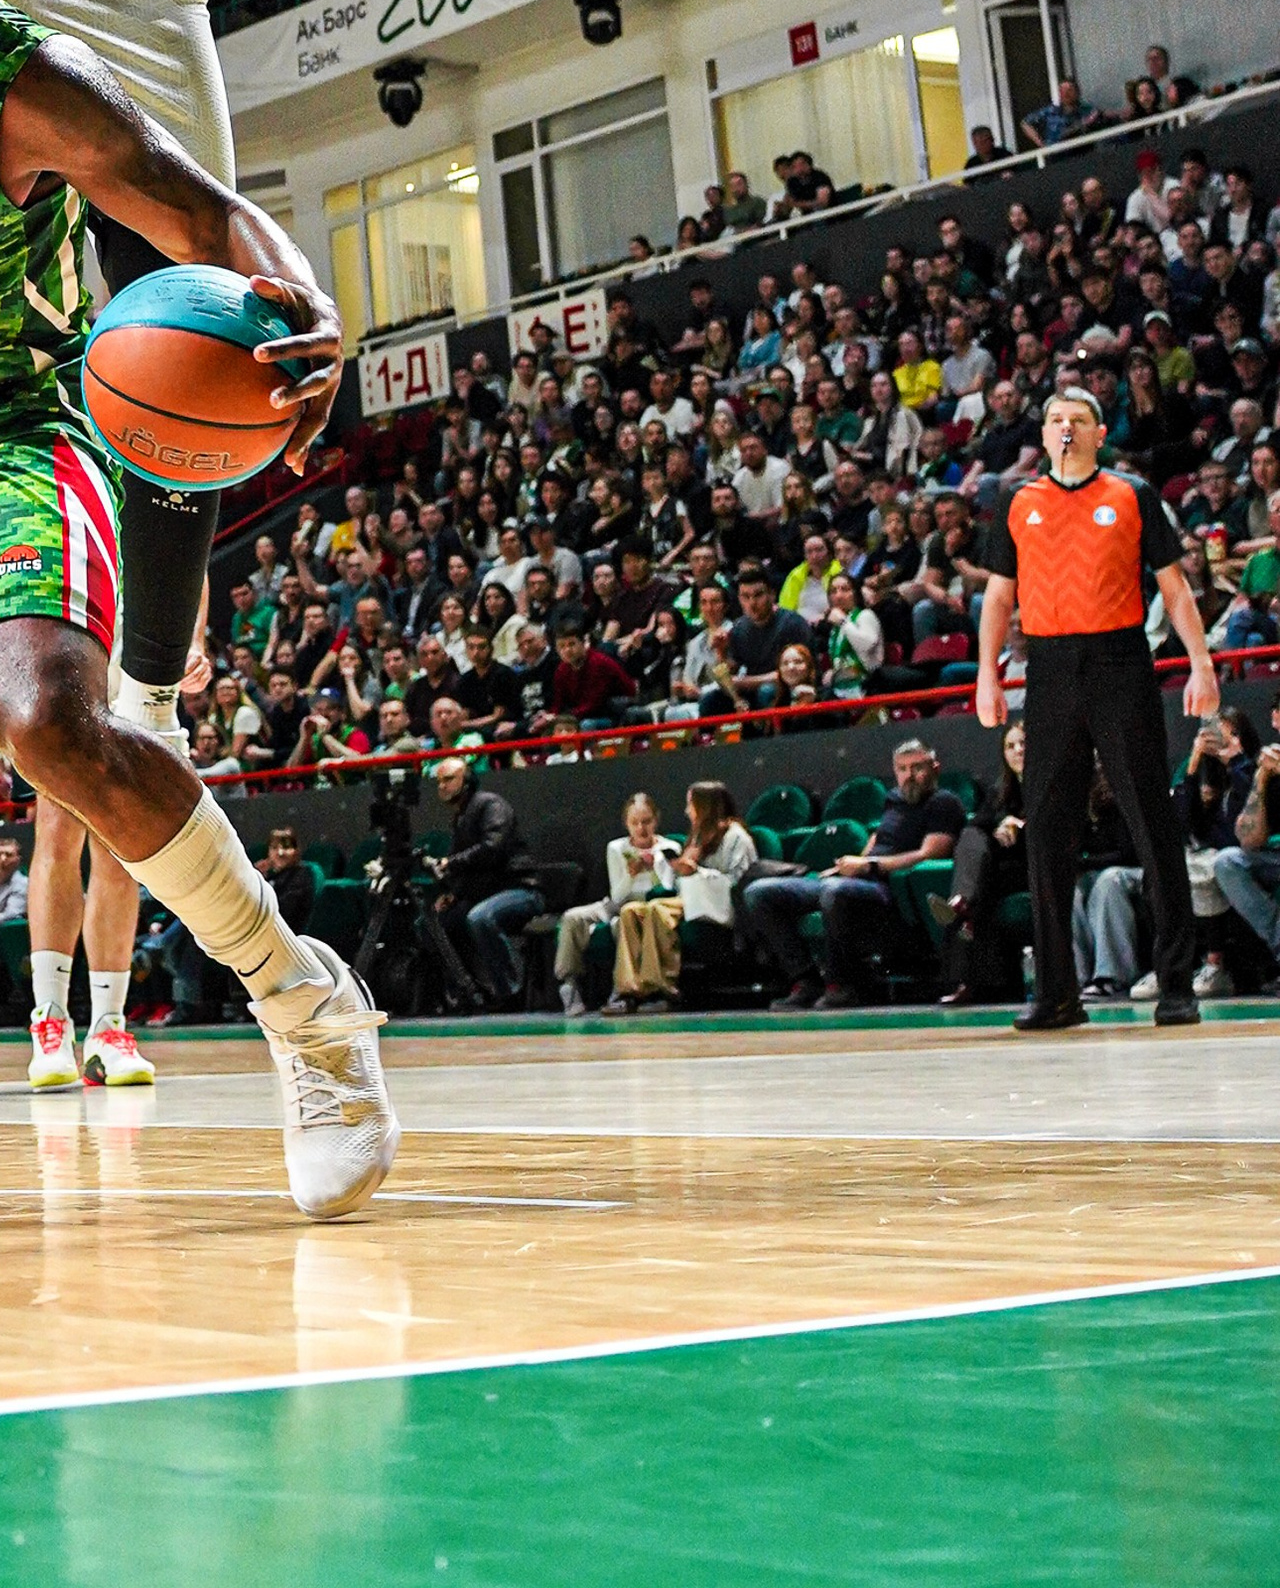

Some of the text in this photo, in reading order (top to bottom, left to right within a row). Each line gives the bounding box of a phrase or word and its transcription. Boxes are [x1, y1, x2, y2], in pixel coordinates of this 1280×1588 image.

[296, 0, 368, 44] Ак Барс
[297, 34, 340, 68] Банк
[376, 346, 432, 403] 1-Д
[109, 425, 244, 473] JÖGEL
[151, 496, 199, 514] KELME
